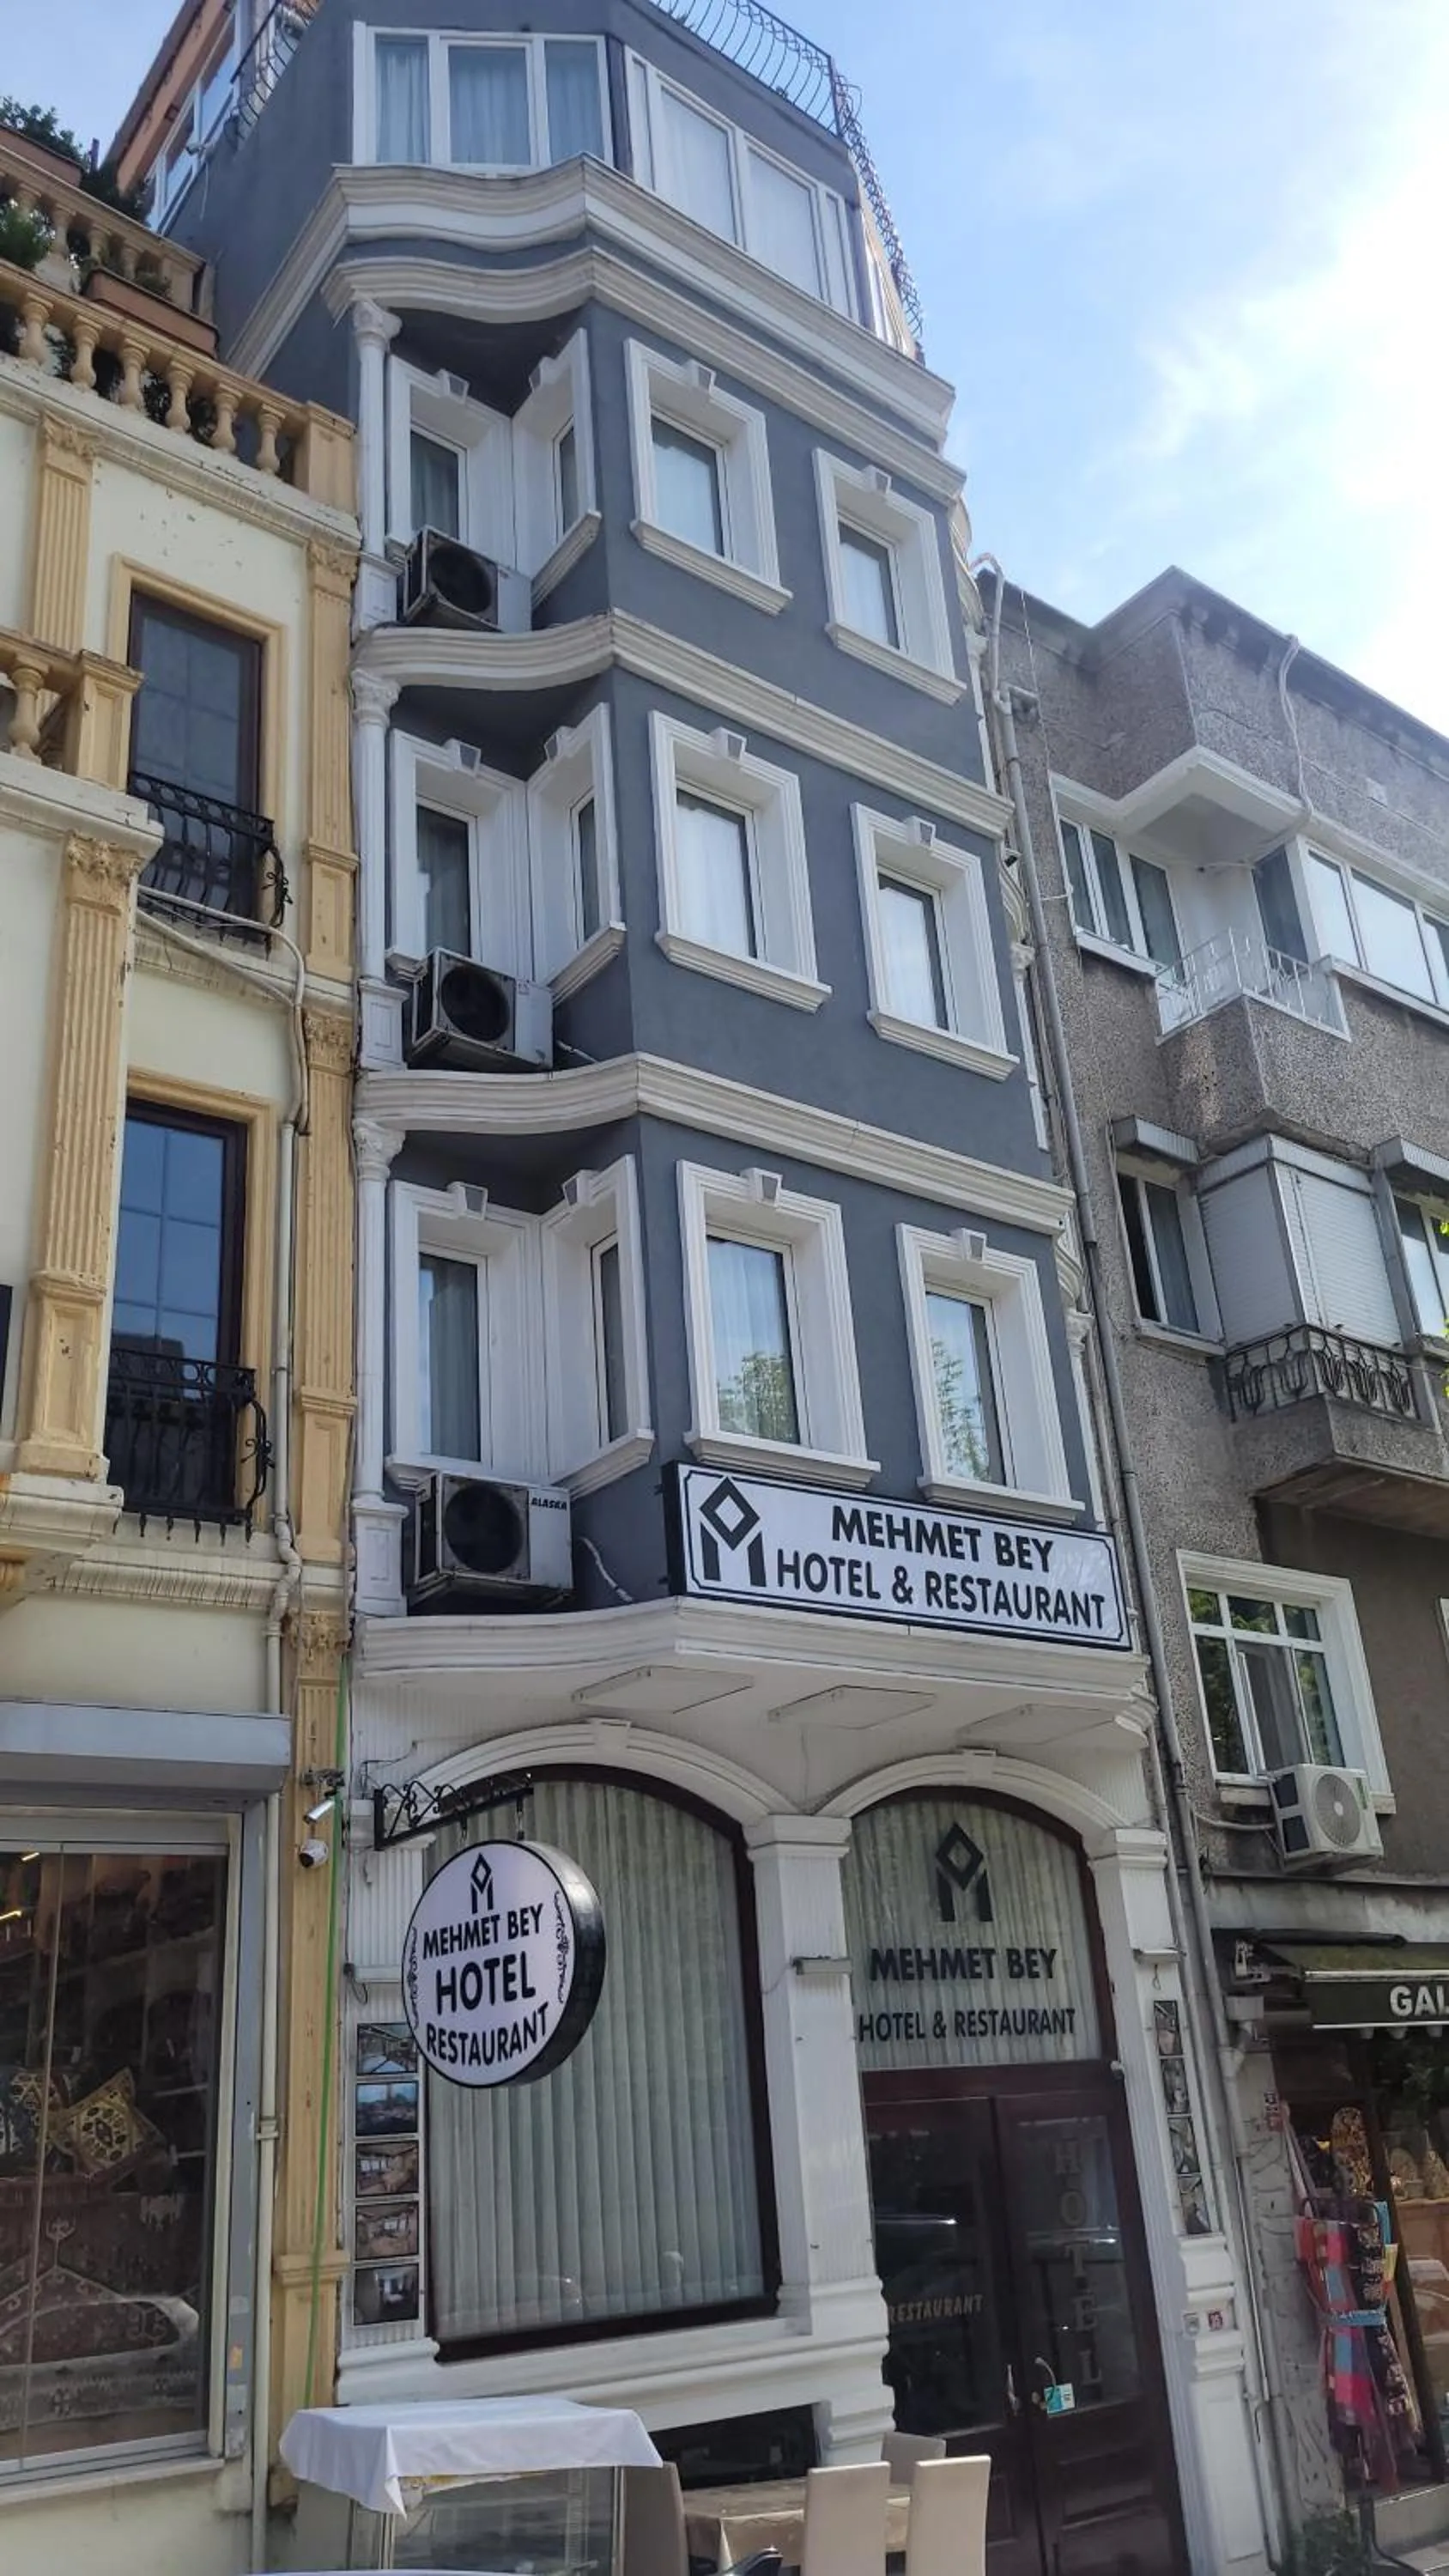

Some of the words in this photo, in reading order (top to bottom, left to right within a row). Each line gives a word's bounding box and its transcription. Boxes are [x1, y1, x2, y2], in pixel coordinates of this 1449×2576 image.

[833, 1505, 981, 1563] MEHMET
[994, 1533, 1054, 1572] BEY
[777, 1548, 881, 1600] HOTEL
[892, 1565, 913, 1604] &
[925, 1571, 1105, 1629] RESTAURANT
[422, 1913, 500, 1959] MEHMET
[507, 1903, 544, 1938] BEY
[436, 1951, 536, 2015] HOTEL
[870, 1948, 996, 1981] MEHMET
[1006, 1948, 1058, 1978] BEY
[427, 2002, 549, 2066] RESTAURANT
[859, 2012, 925, 2042] HOTEL
[932, 2011, 946, 2038] &
[955, 2008, 1075, 2038] RESTAURANT
[888, 2293, 983, 2324] RESTAURANT
